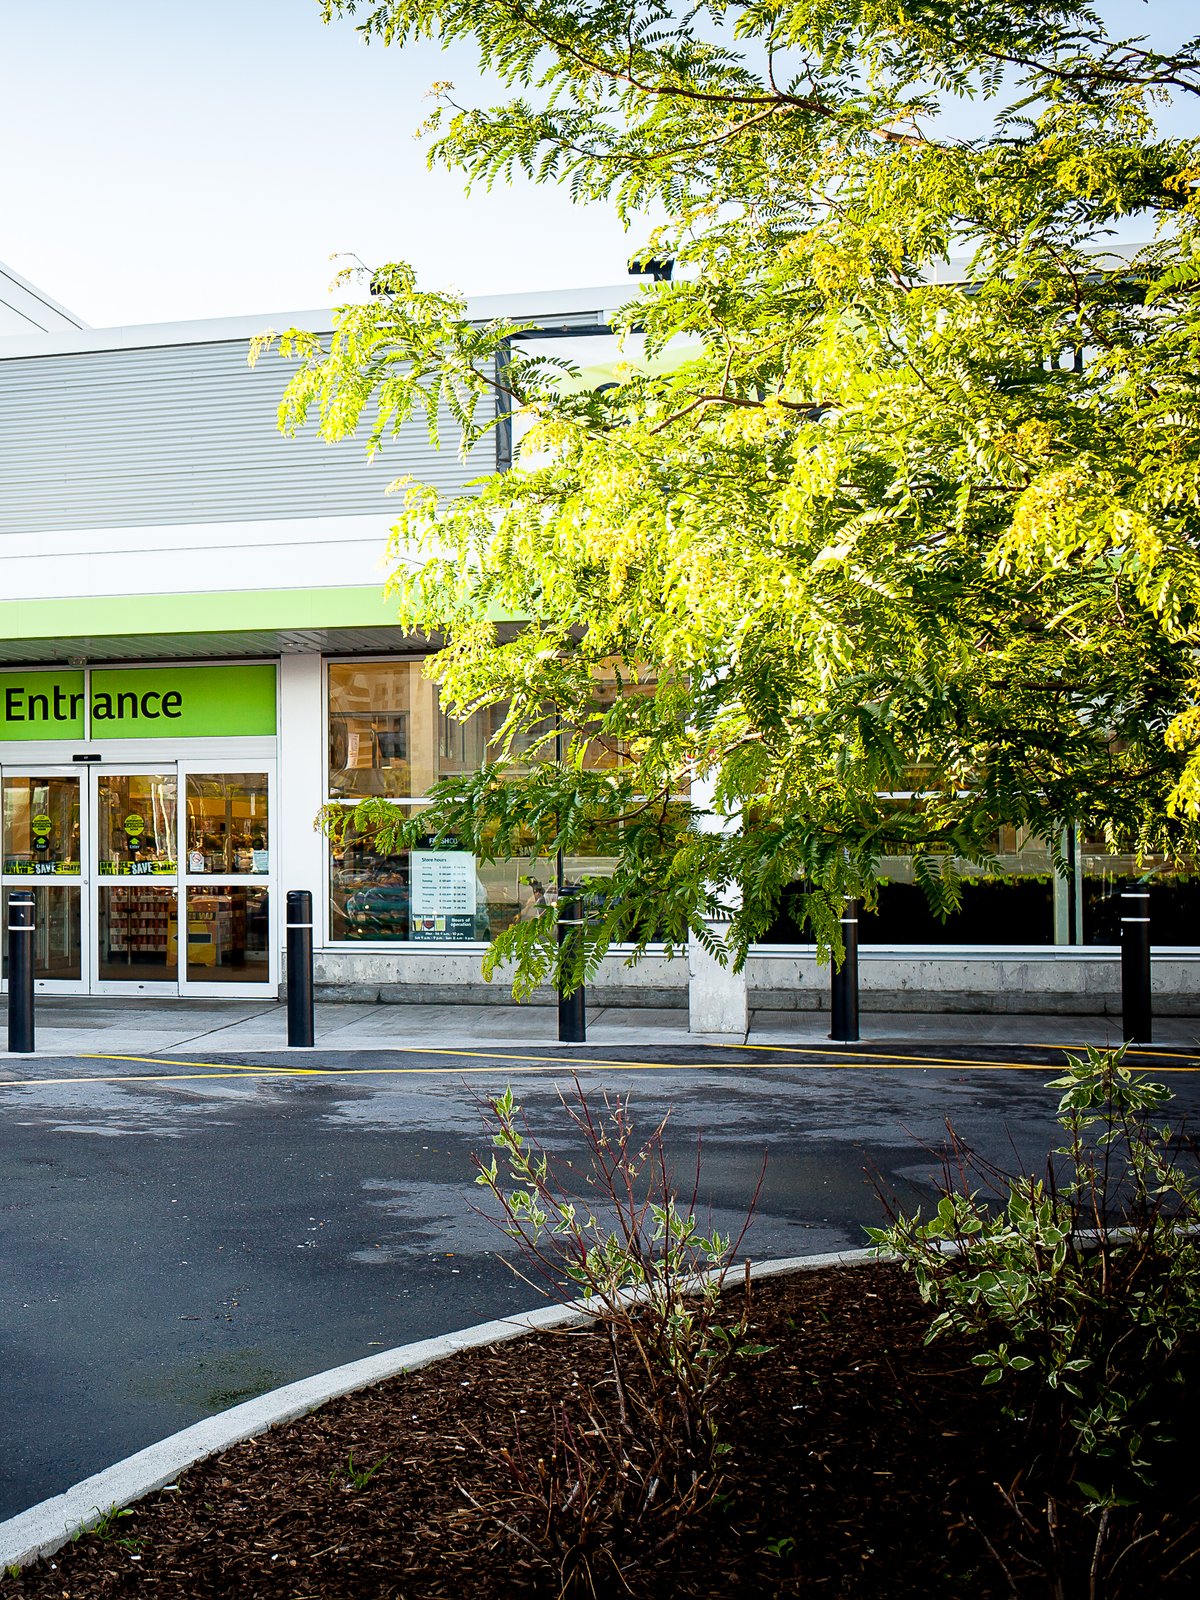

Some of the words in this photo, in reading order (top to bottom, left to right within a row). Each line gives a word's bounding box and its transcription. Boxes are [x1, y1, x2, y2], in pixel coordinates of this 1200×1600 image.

[5, 685, 182, 721] Entrance
[35, 863, 57, 874] SAVE
[131, 862, 153, 875] SAVE
